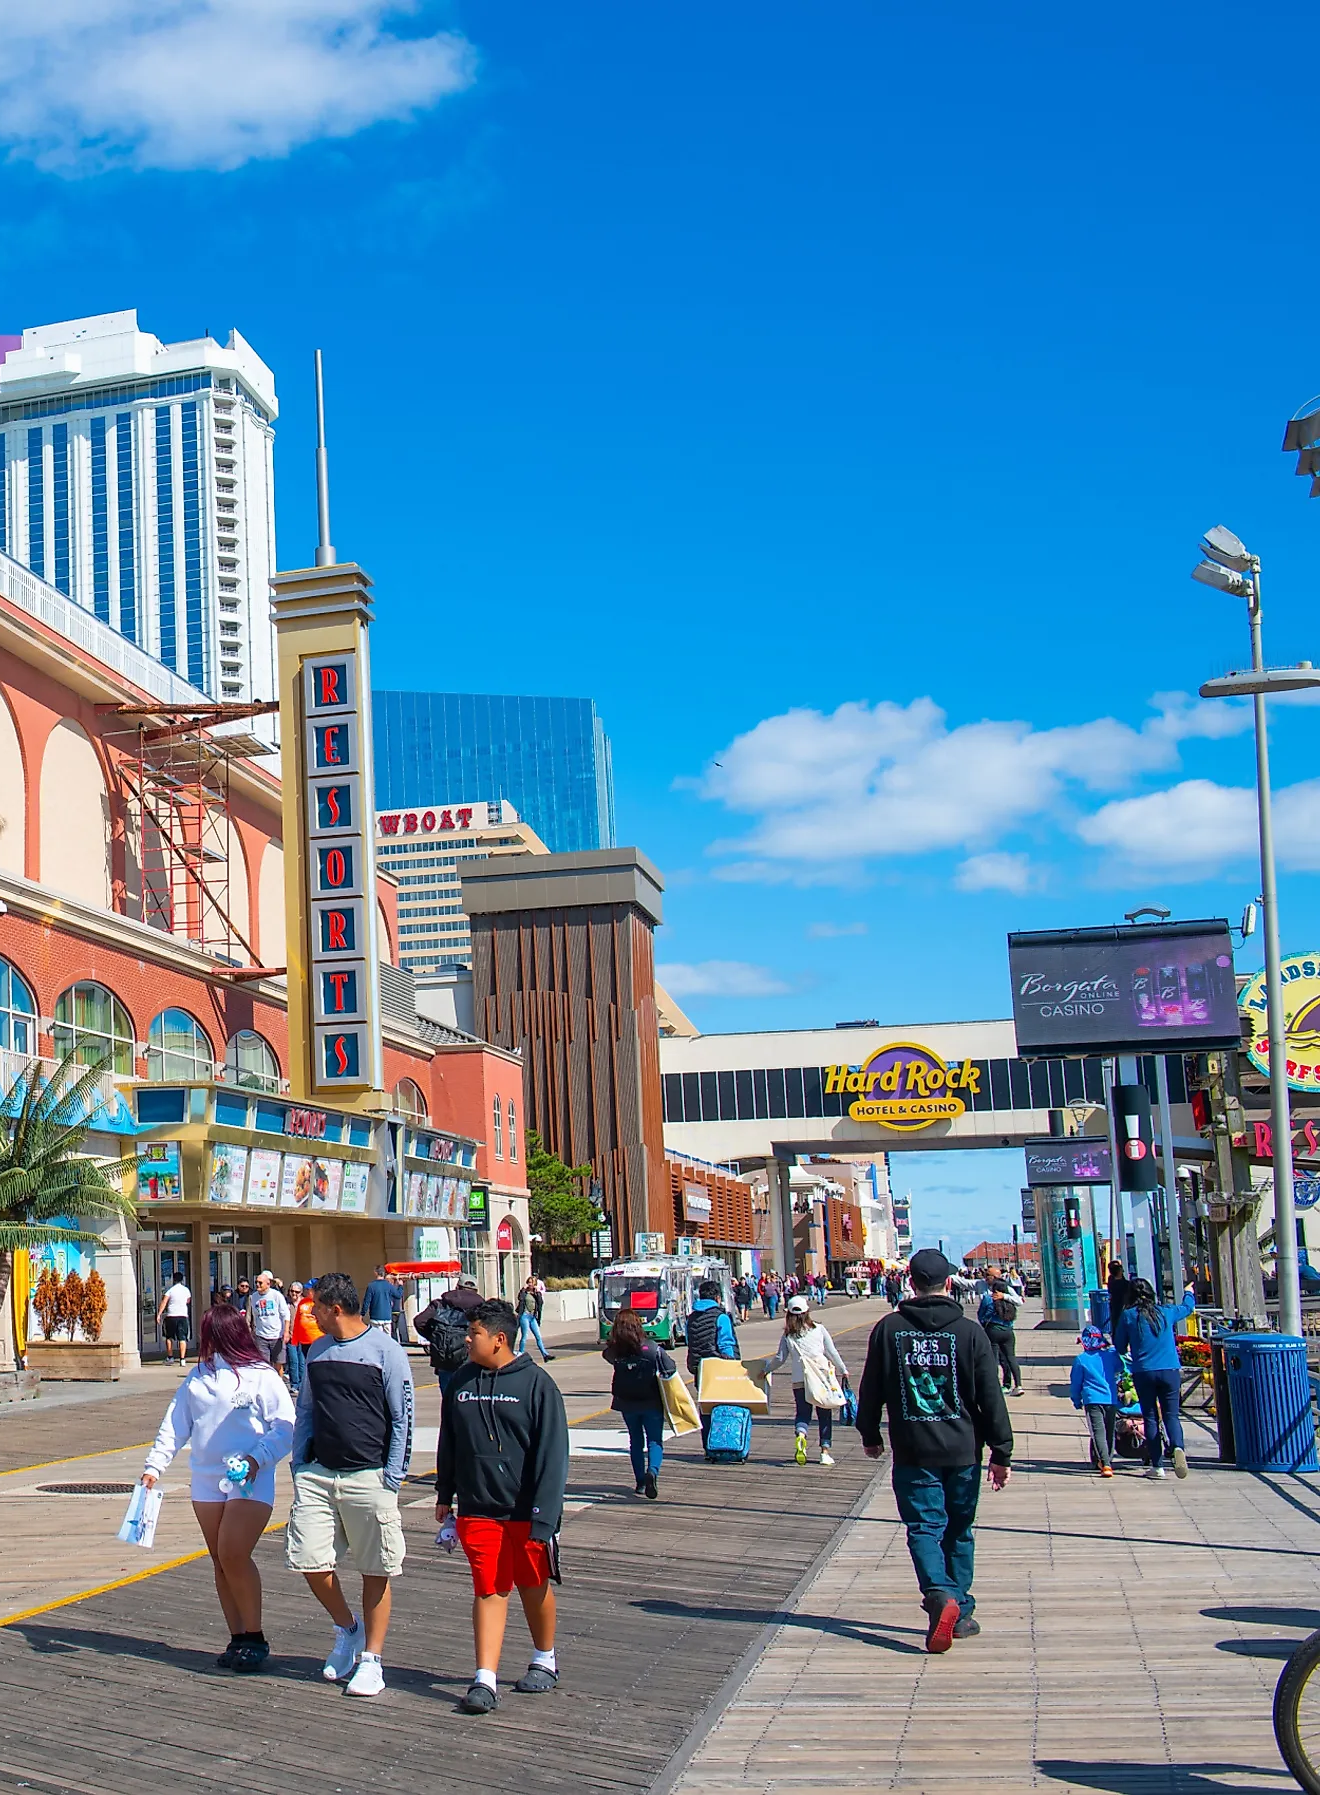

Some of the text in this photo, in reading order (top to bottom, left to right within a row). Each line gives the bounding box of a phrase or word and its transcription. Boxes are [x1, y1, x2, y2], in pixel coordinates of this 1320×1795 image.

[321, 667, 349, 1074] RESORTS
[1020, 973, 1118, 1003] Borgata
[1080, 990, 1120, 999] ONLINE
[1040, 1003, 1104, 1018] CASINO
[824, 1057, 981, 1097] Hard Rock
[856, 1103, 958, 1116] HOTEL & CASINO
[1253, 1120, 1318, 1157] RS
[904, 1352, 949, 1366] LEGEND
[458, 1390, 520, 1406] Champion
